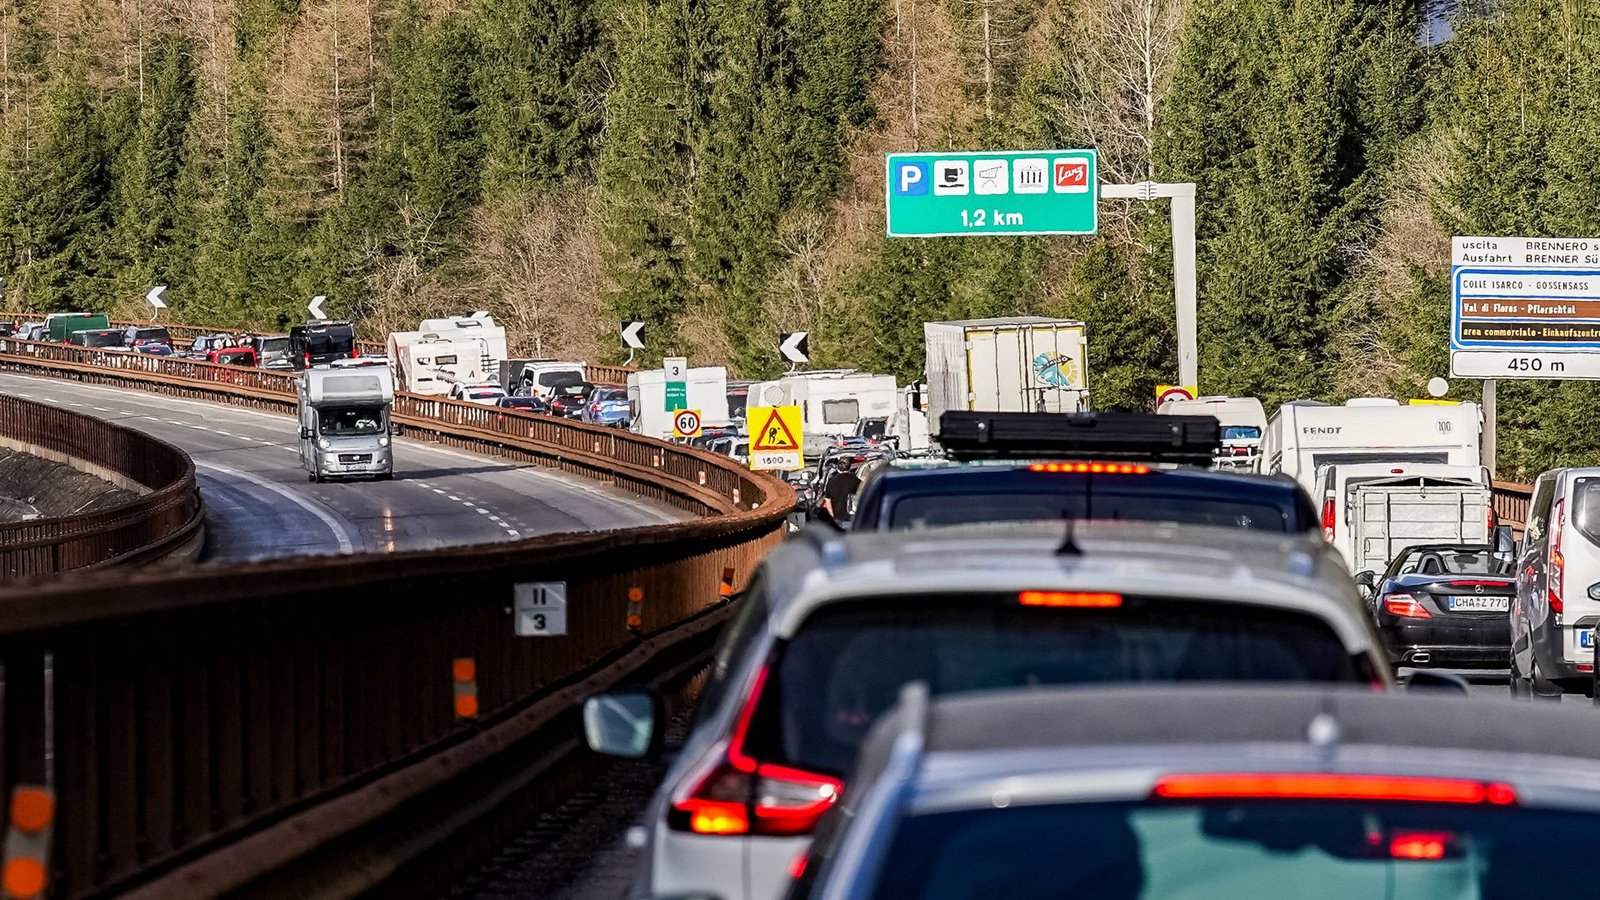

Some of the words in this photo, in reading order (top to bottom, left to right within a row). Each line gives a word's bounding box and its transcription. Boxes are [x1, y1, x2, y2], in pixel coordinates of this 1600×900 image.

[901, 166, 922, 191] P
[961, 208, 986, 228] 1,2
[993, 209, 1024, 226] km
[1462, 241, 1498, 250] uscita
[1526, 241, 1588, 251] BRENNERO
[1462, 253, 1512, 263] Ausfahrt
[1526, 254, 1579, 264] BRENNER
[1463, 280, 1487, 289] COLLE
[1492, 281, 1523, 290] ISARCO
[1536, 282, 1589, 290] GOSSENSASS
[1463, 303, 1477, 312] Val
[1481, 303, 1489, 312] di
[1507, 358, 1543, 371] 450
[1550, 360, 1565, 372] m
[672, 366, 679, 376] 3
[680, 417, 695, 429] 60
[1303, 426, 1343, 435] FENDT
[1455, 598, 1475, 607] CHA
[1481, 599, 1487, 607] Z
[1489, 599, 1508, 608] 770
[533, 613, 546, 630] 3
